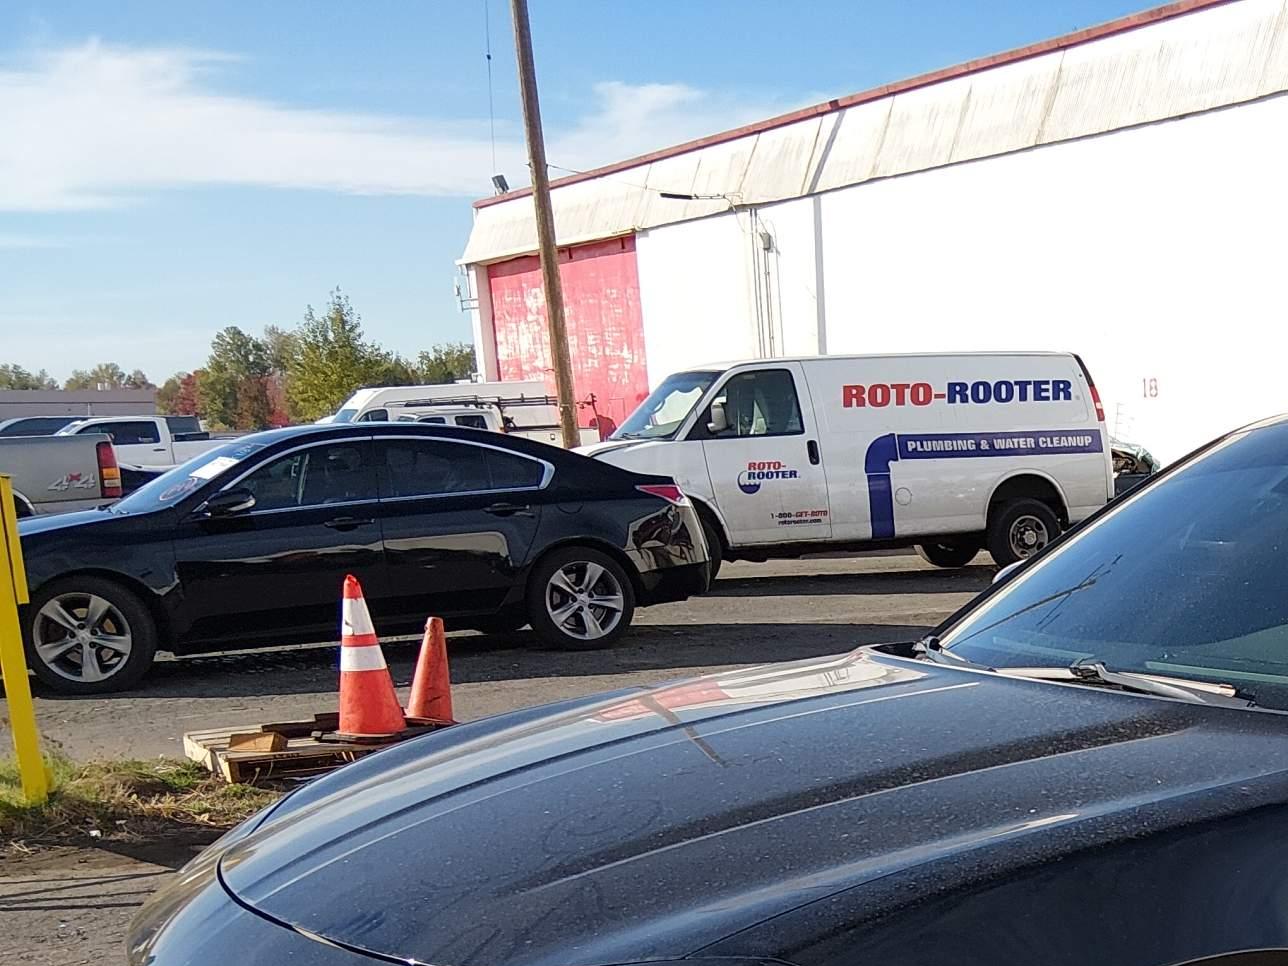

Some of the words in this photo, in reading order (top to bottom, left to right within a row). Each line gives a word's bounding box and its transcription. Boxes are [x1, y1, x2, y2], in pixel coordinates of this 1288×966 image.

[842, 379, 1072, 408] ROTO-ROOTER
[1143, 378, 1158, 398] 18
[907, 438, 976, 452] PLUMBING
[980, 439, 990, 450] &
[993, 436, 1035, 450] WATER
[1038, 435, 1093, 448] CLEANUP
[748, 461, 786, 470] ROTO-
[747, 470, 797, 480] ROOTER
